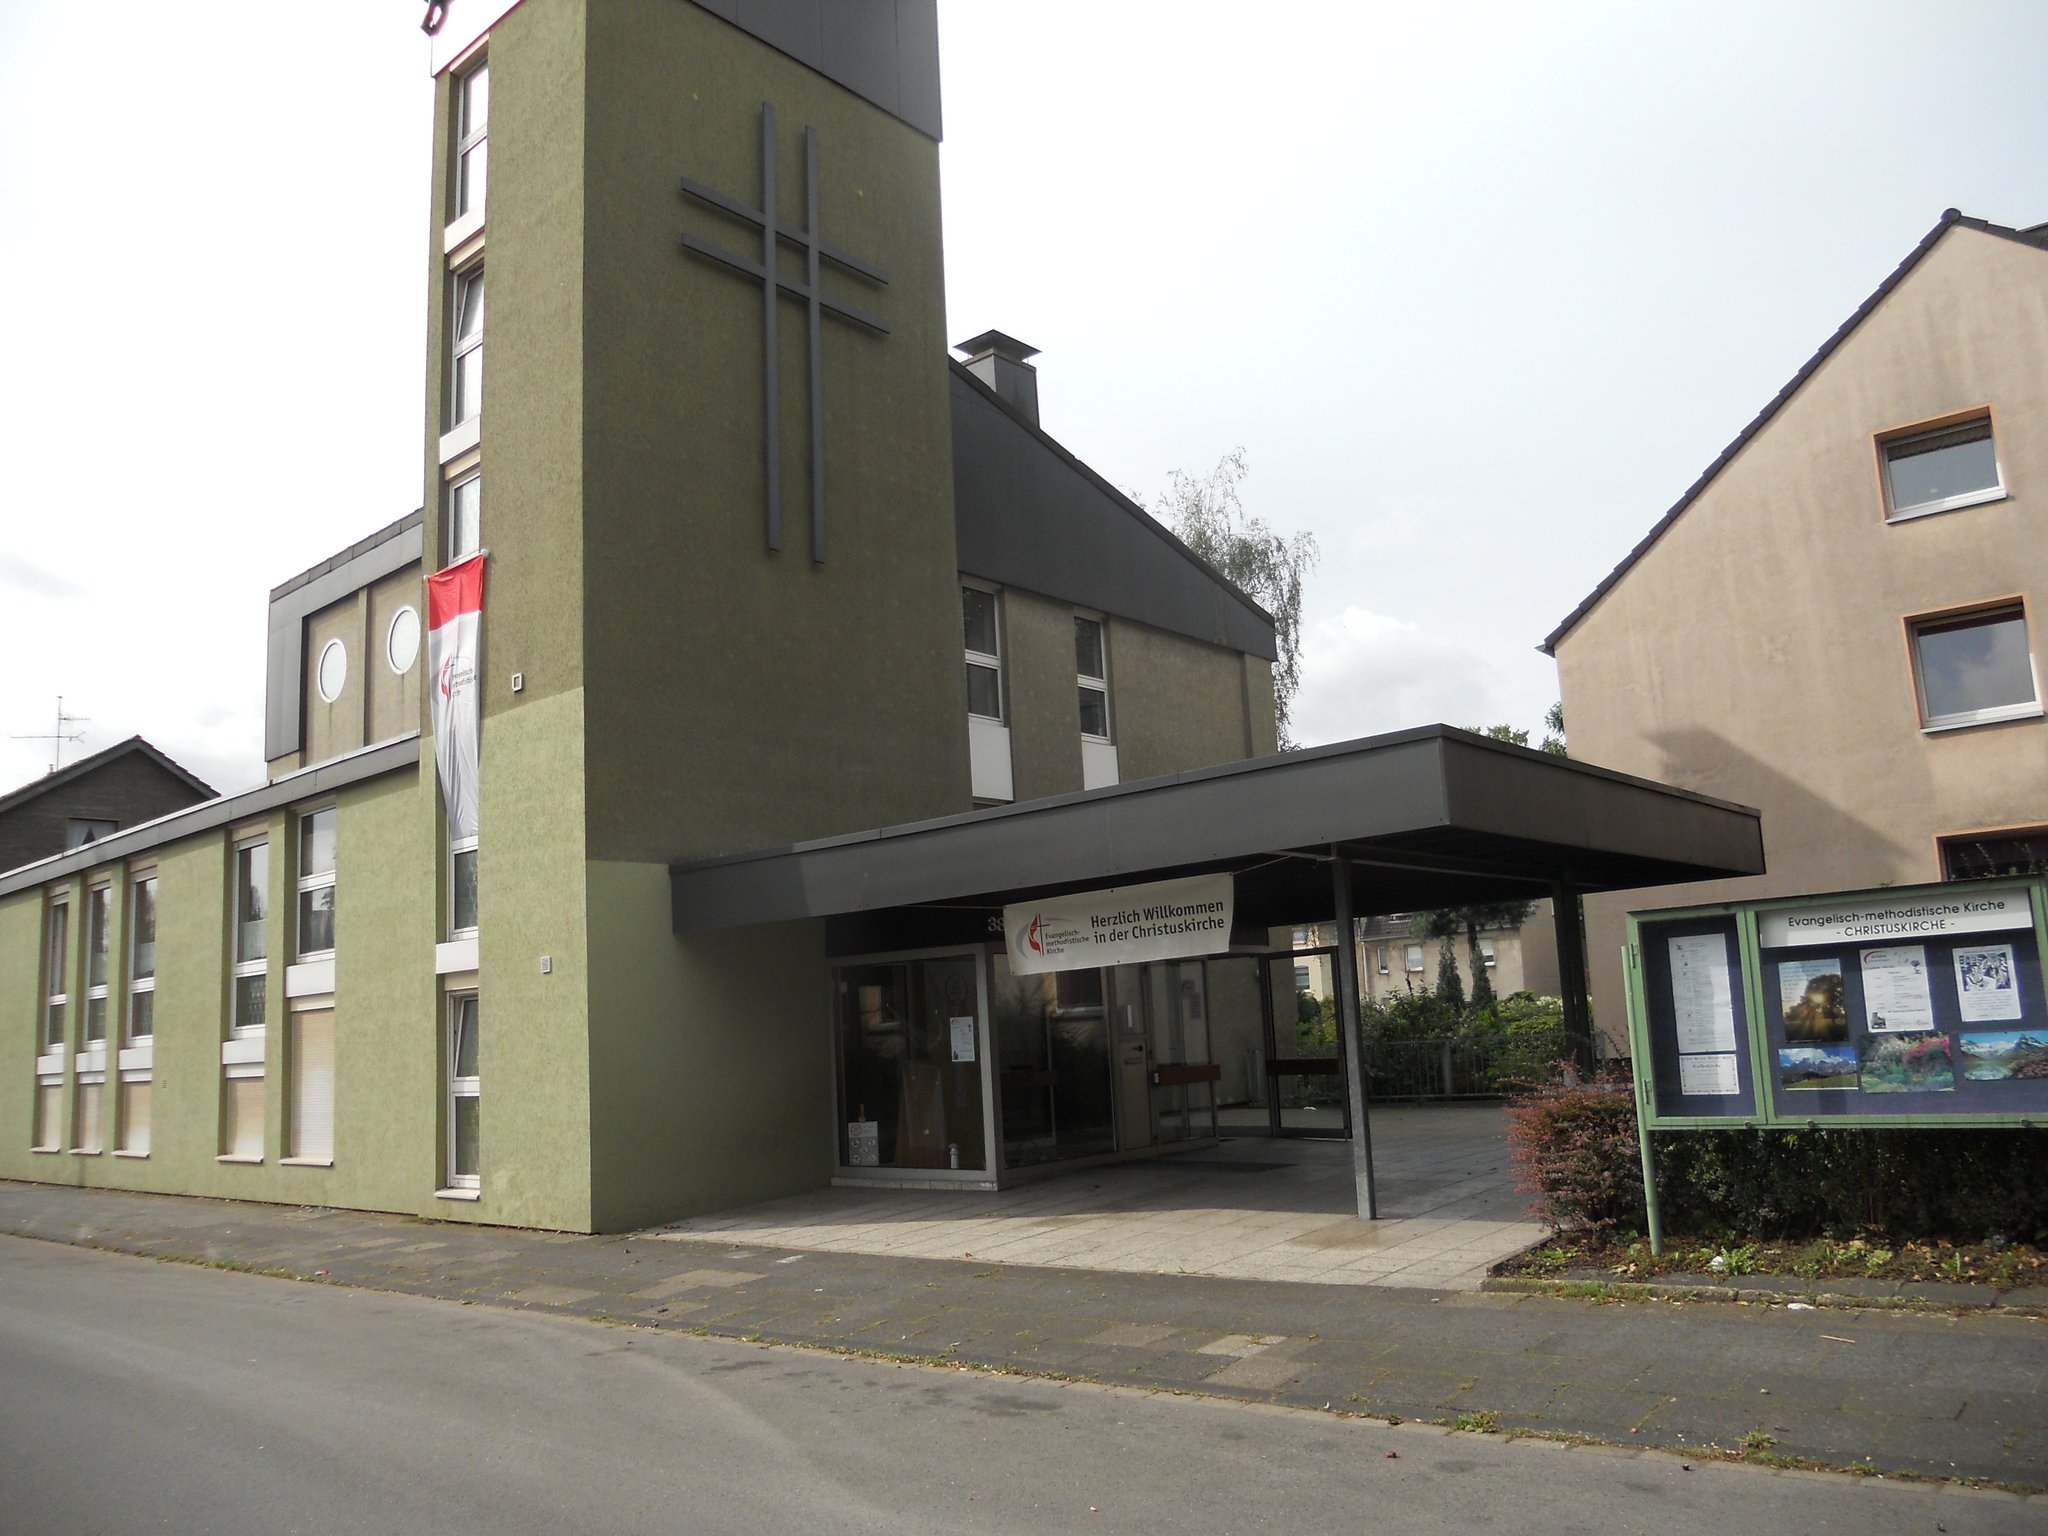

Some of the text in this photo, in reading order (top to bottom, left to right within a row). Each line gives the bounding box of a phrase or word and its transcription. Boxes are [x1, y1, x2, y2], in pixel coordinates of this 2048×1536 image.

[1091, 901, 1224, 928] Herzlich Willkommen
[1788, 900, 2005, 927] Evangelisch-methodistische Kirche
[1045, 929, 1081, 939] Evangelisch-
[1094, 917, 1225, 944] in der Christuskirche
[1844, 919, 1946, 937] CHRISTUSKIRCHE
[1045, 936, 1090, 947] methodistische
